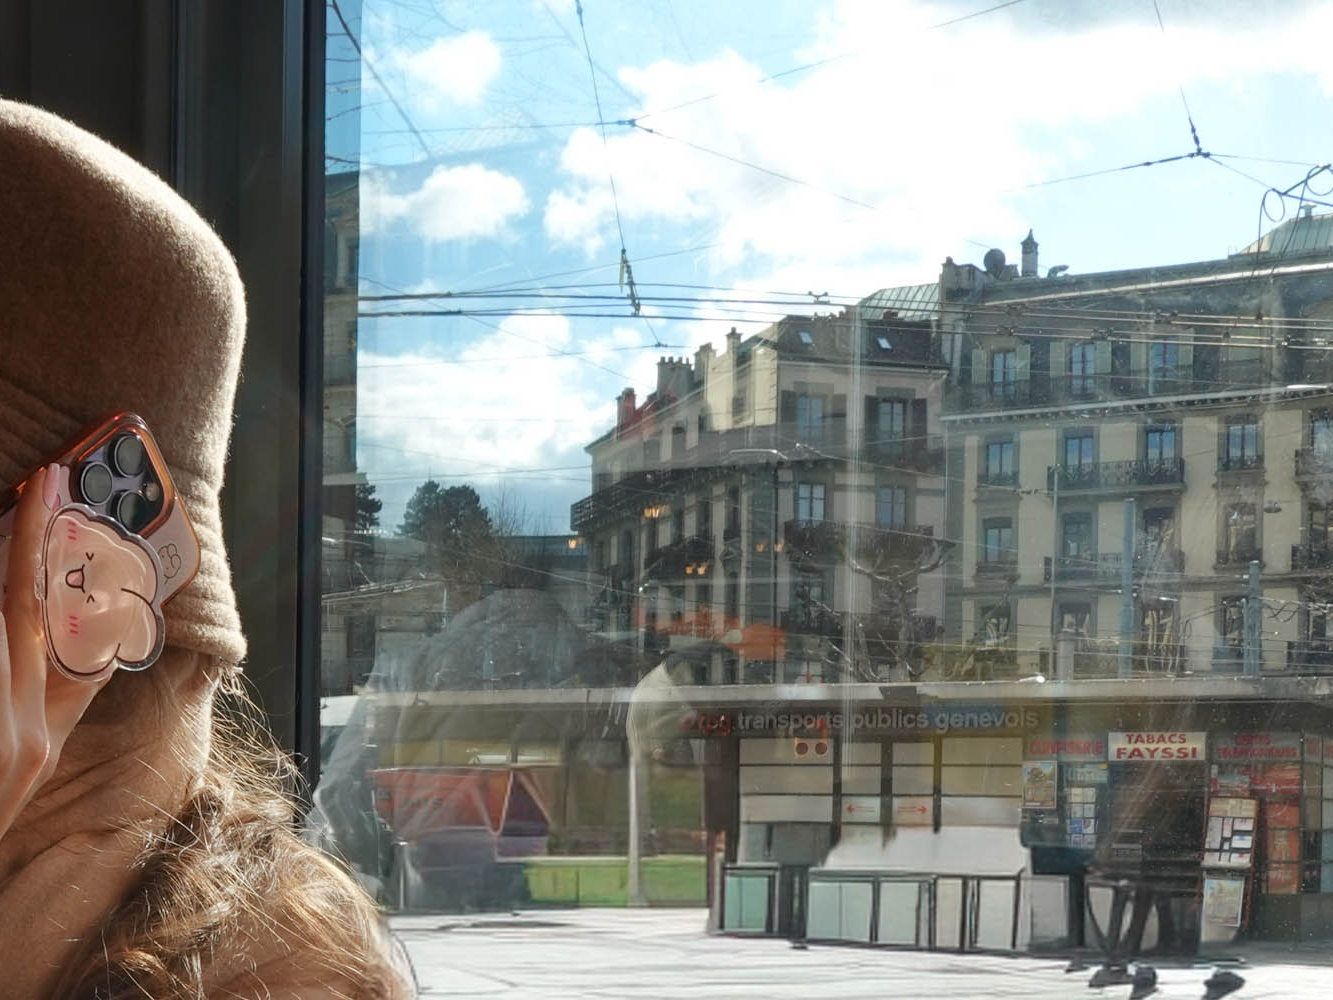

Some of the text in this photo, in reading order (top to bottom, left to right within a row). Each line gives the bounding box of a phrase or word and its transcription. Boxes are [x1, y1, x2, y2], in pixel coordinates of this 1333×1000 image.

[737, 712, 843, 734] transports
[850, 709, 929, 733] publics
[935, 709, 1039, 732] genevois
[1126, 733, 1186, 745] TABACS
[1116, 746, 1197, 759] FAYSSI
